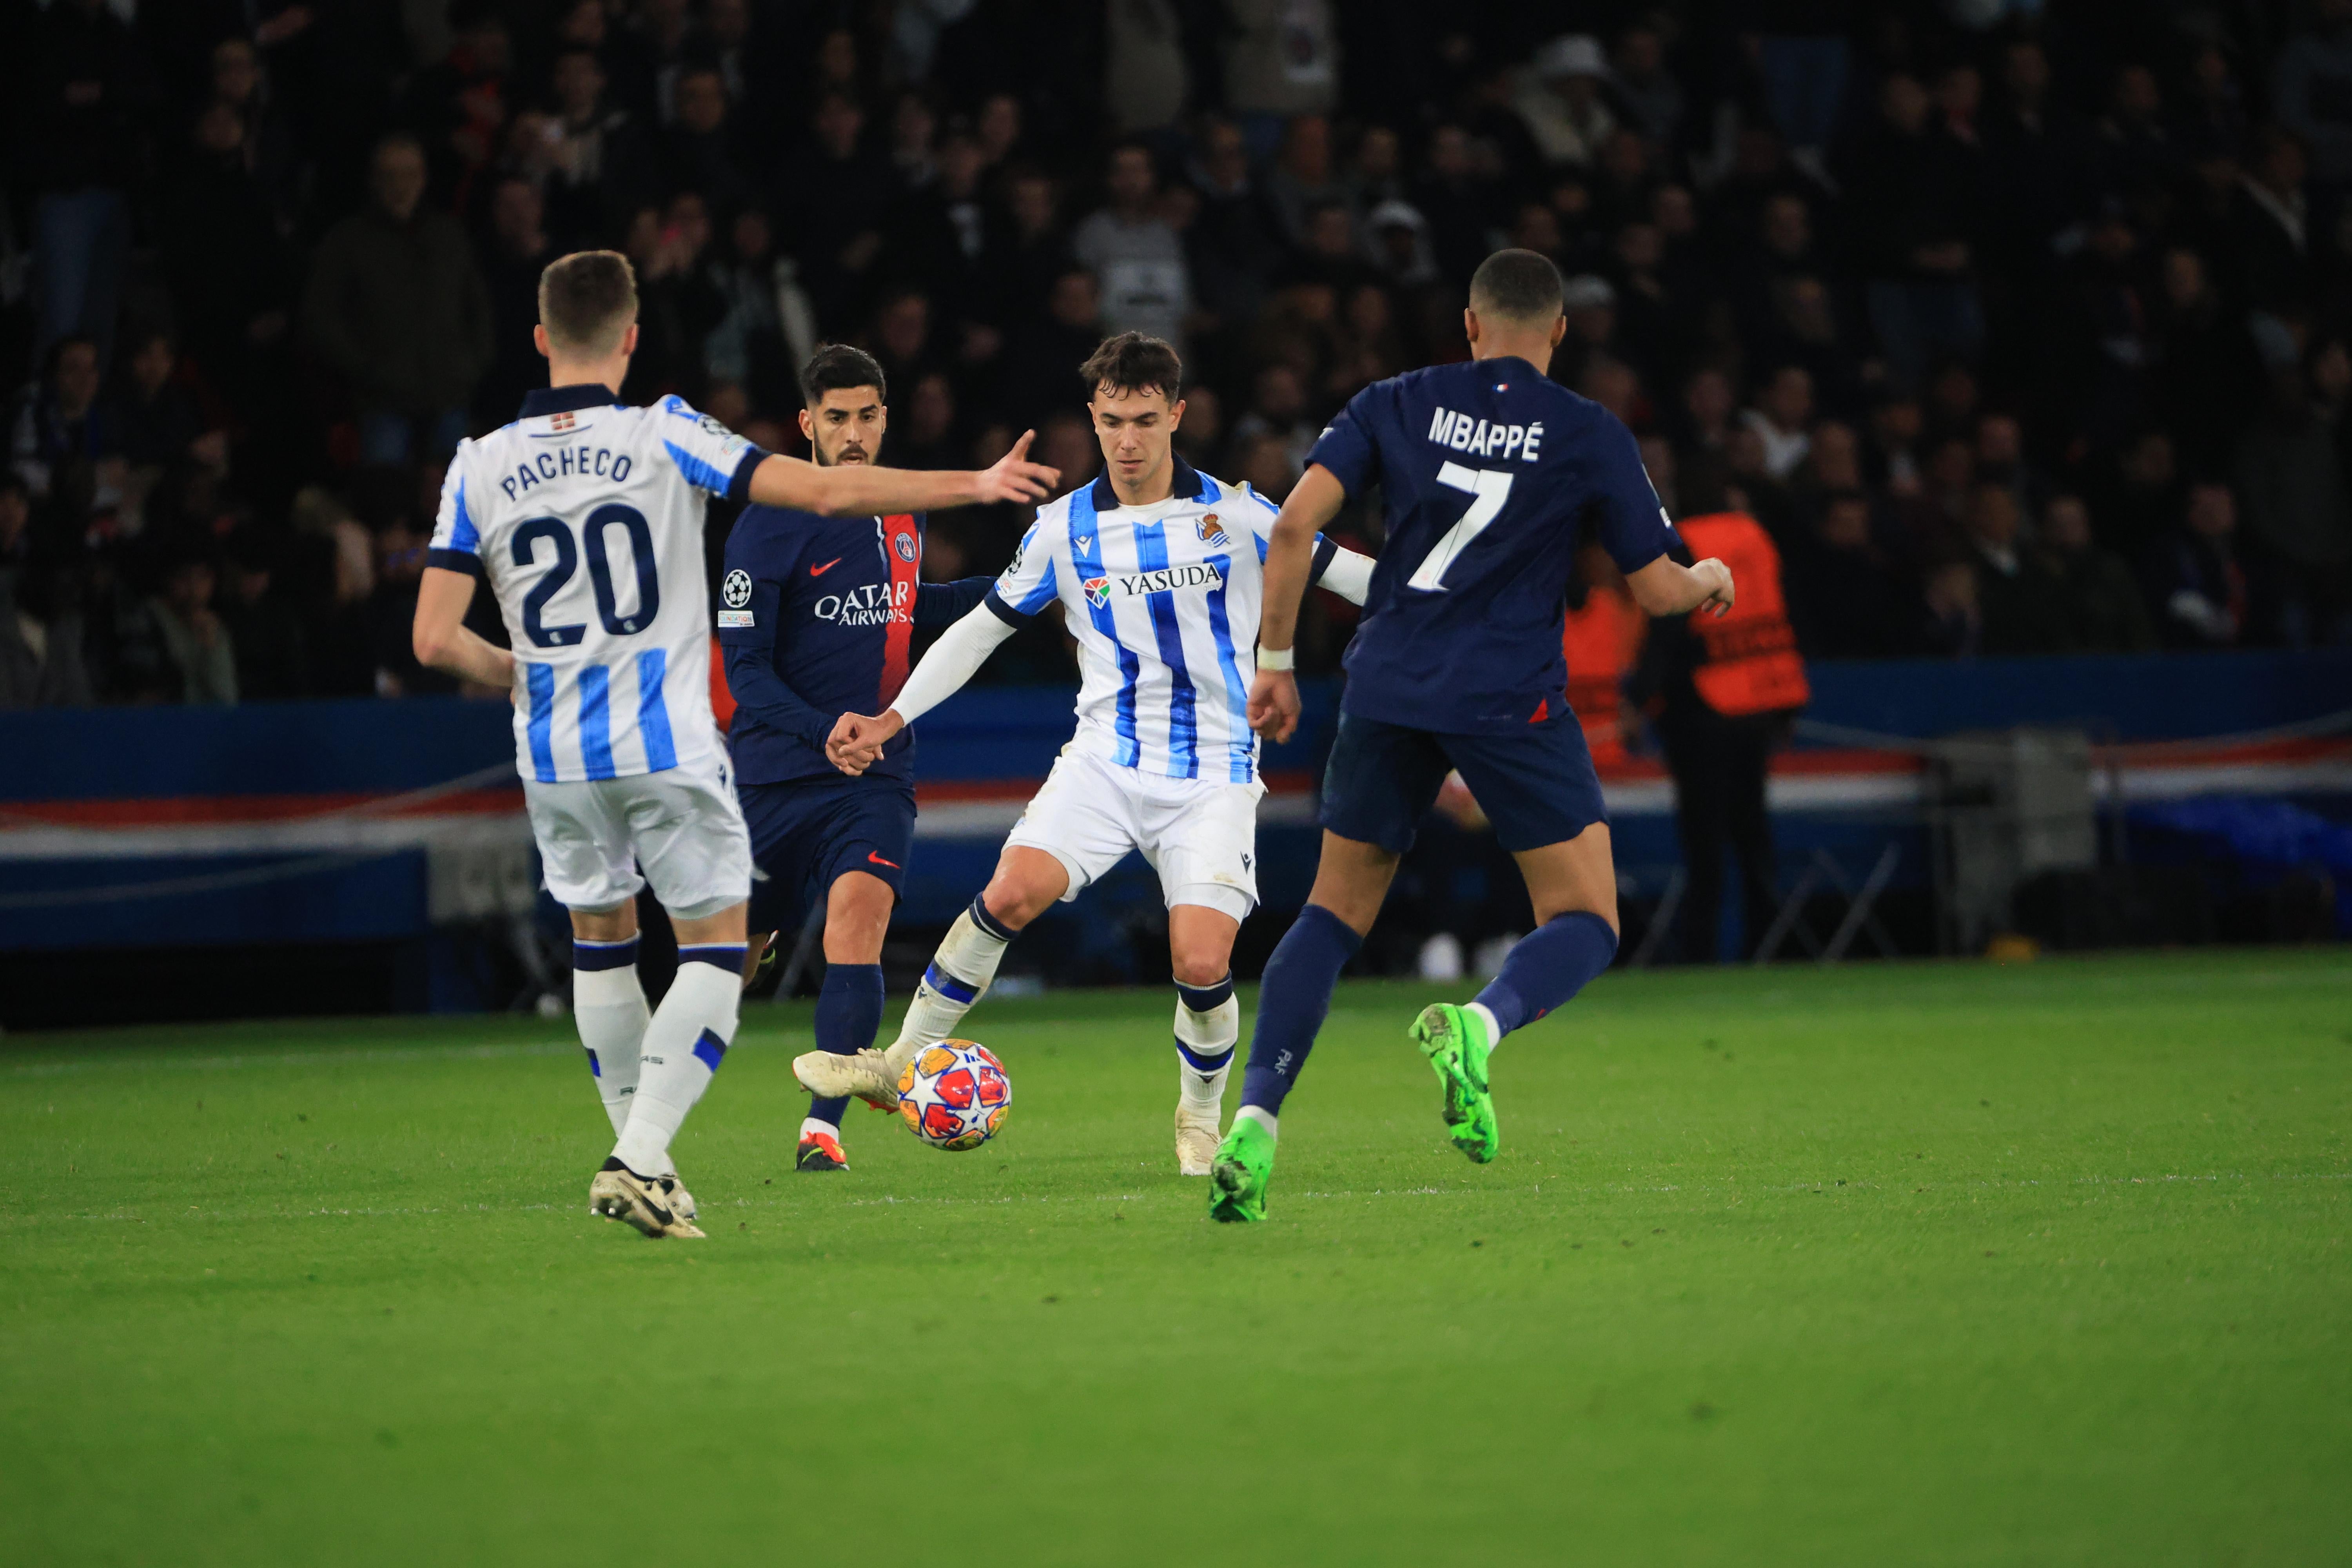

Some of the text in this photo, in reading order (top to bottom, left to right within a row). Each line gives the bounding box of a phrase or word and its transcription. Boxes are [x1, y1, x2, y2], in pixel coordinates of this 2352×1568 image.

[1428, 406, 1544, 462] MBAPPÉ
[500, 446, 632, 502] PACHECO
[1406, 460, 1514, 592] 7
[511, 503, 659, 648] 20
[814, 581, 909, 620] QATAR
[1118, 563, 1221, 595] YASUDA
[1203, 583, 1221, 593] group
